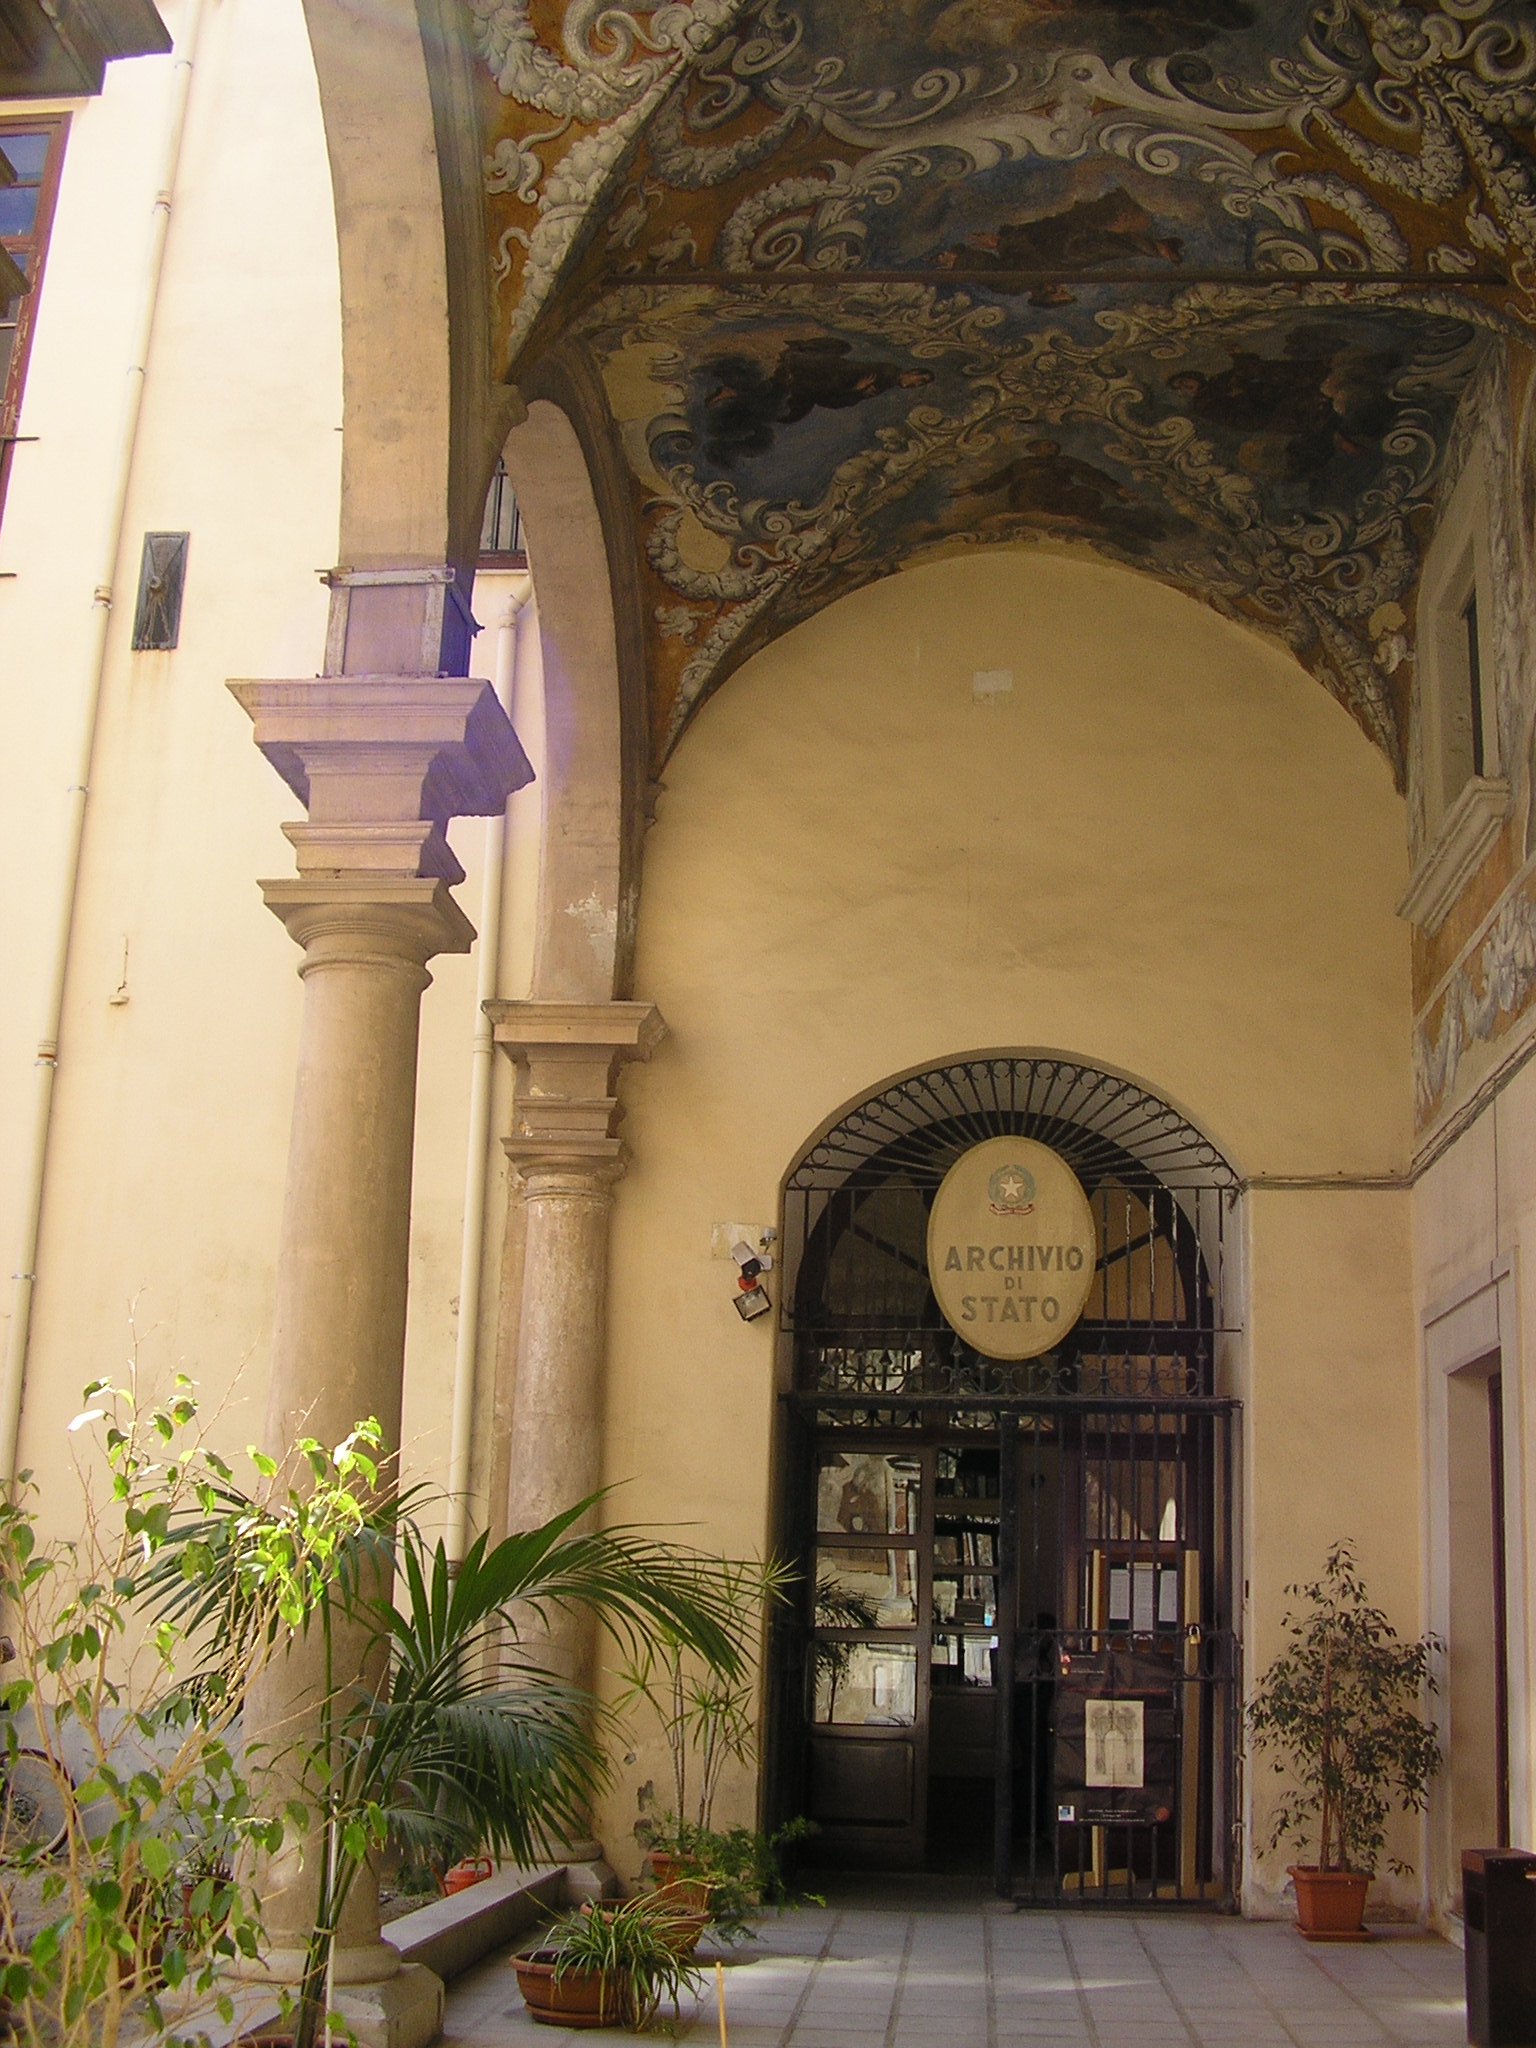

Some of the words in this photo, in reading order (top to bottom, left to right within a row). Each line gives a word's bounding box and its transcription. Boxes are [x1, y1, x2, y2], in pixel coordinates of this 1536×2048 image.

[945, 1246, 1084, 1272] ARCHIVIO
[1004, 1276, 1023, 1290] DI
[961, 1296, 1061, 1323] STATO
